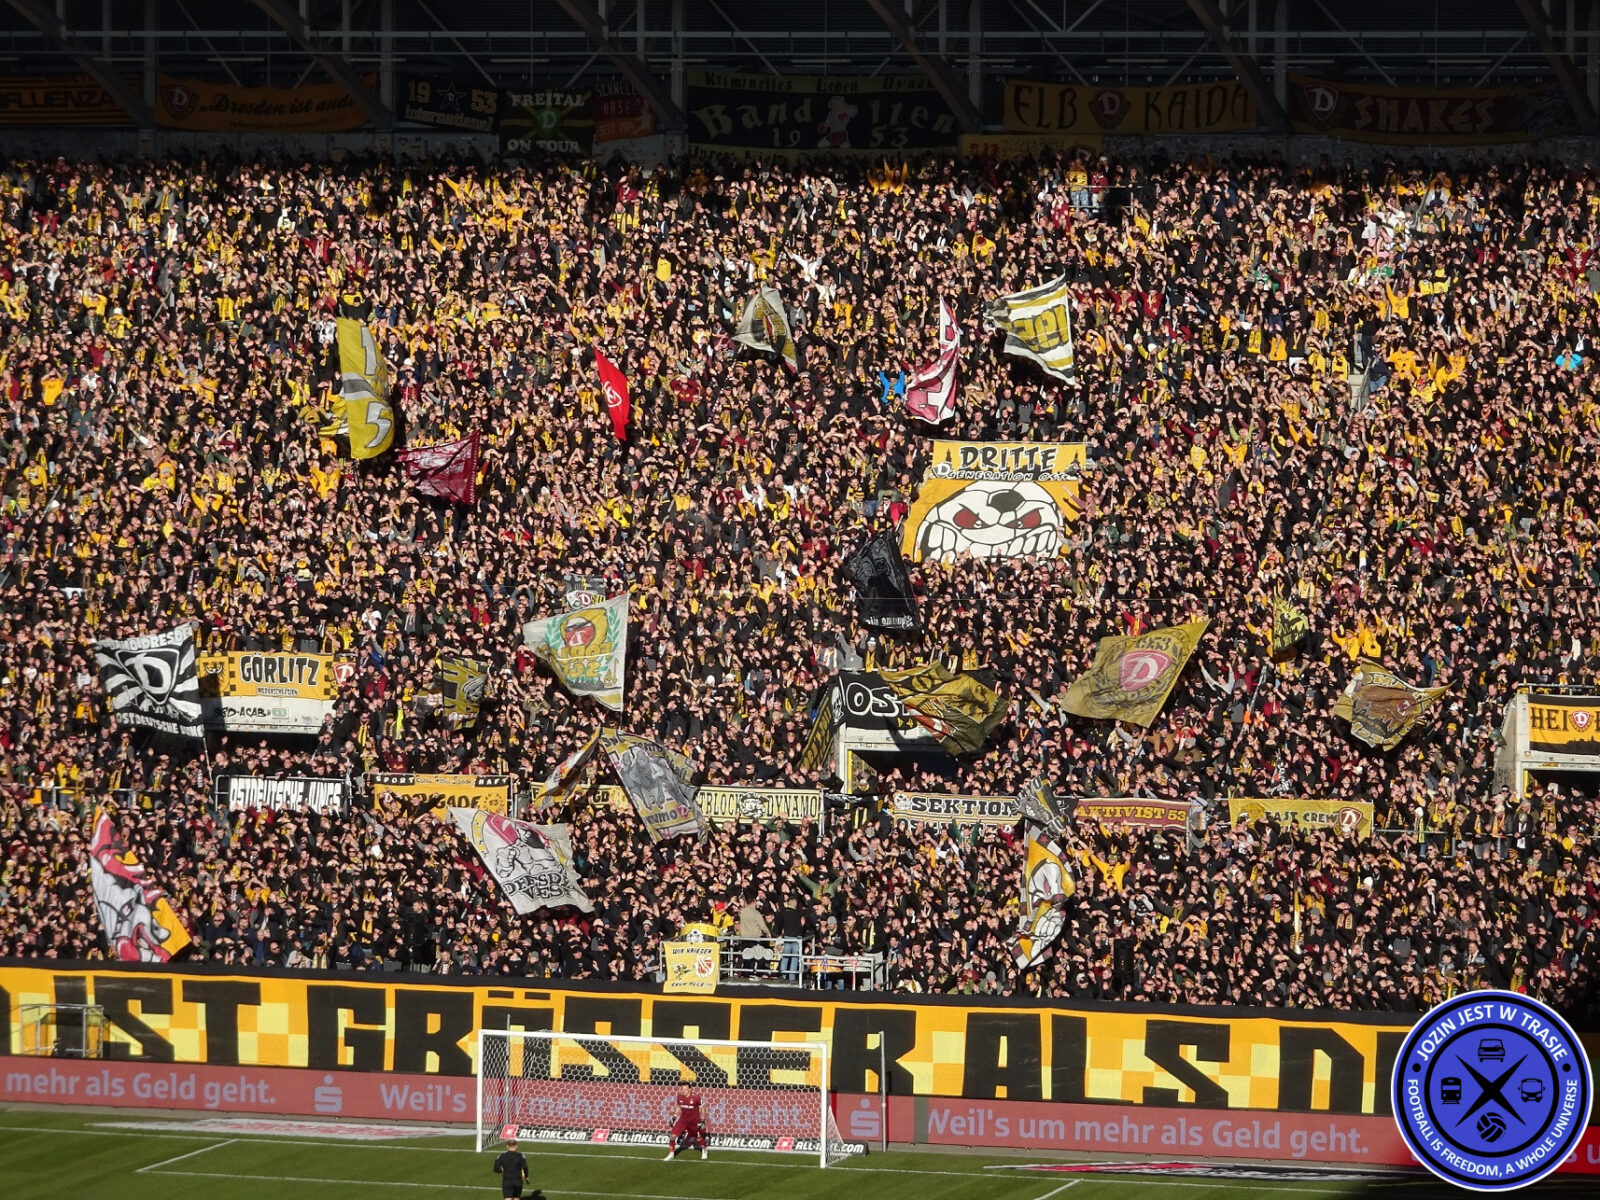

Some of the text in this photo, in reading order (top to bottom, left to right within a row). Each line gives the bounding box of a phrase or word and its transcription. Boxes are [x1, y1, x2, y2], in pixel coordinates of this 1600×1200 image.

[407, 80, 431, 104] 19
[470, 89, 498, 115] 53
[511, 92, 586, 108] FREITAL
[1354, 96, 1496, 135] SNAKES
[507, 138, 531, 153] ON
[960, 445, 1057, 472] DRITTE
[947, 470, 1034, 482] GENERATION
[125, 652, 172, 694] D
[240, 653, 321, 687] GÖRLITZ
[1122, 654, 1159, 685] D
[230, 777, 304, 813] OSTDEUTSCHE
[767, 794, 819, 818] DYNAMO
[1077, 804, 1187, 822] AKTIVIST 53
[1302, 812, 1339, 824] CREW
[52, 974, 262, 1065] IST
[307, 983, 916, 1097] GRÖSSER
[960, 1012, 1231, 1110] ALS
[6, 1070, 278, 1110] mehr als Geld geht.
[379, 1083, 468, 1114] Weil's
[518, 1127, 588, 1142] ALL-INKL.COM
[708, 1136, 772, 1150] LL-INKL.COM
[928, 1107, 1370, 1159] Weil's um mehr als Geld geht.
